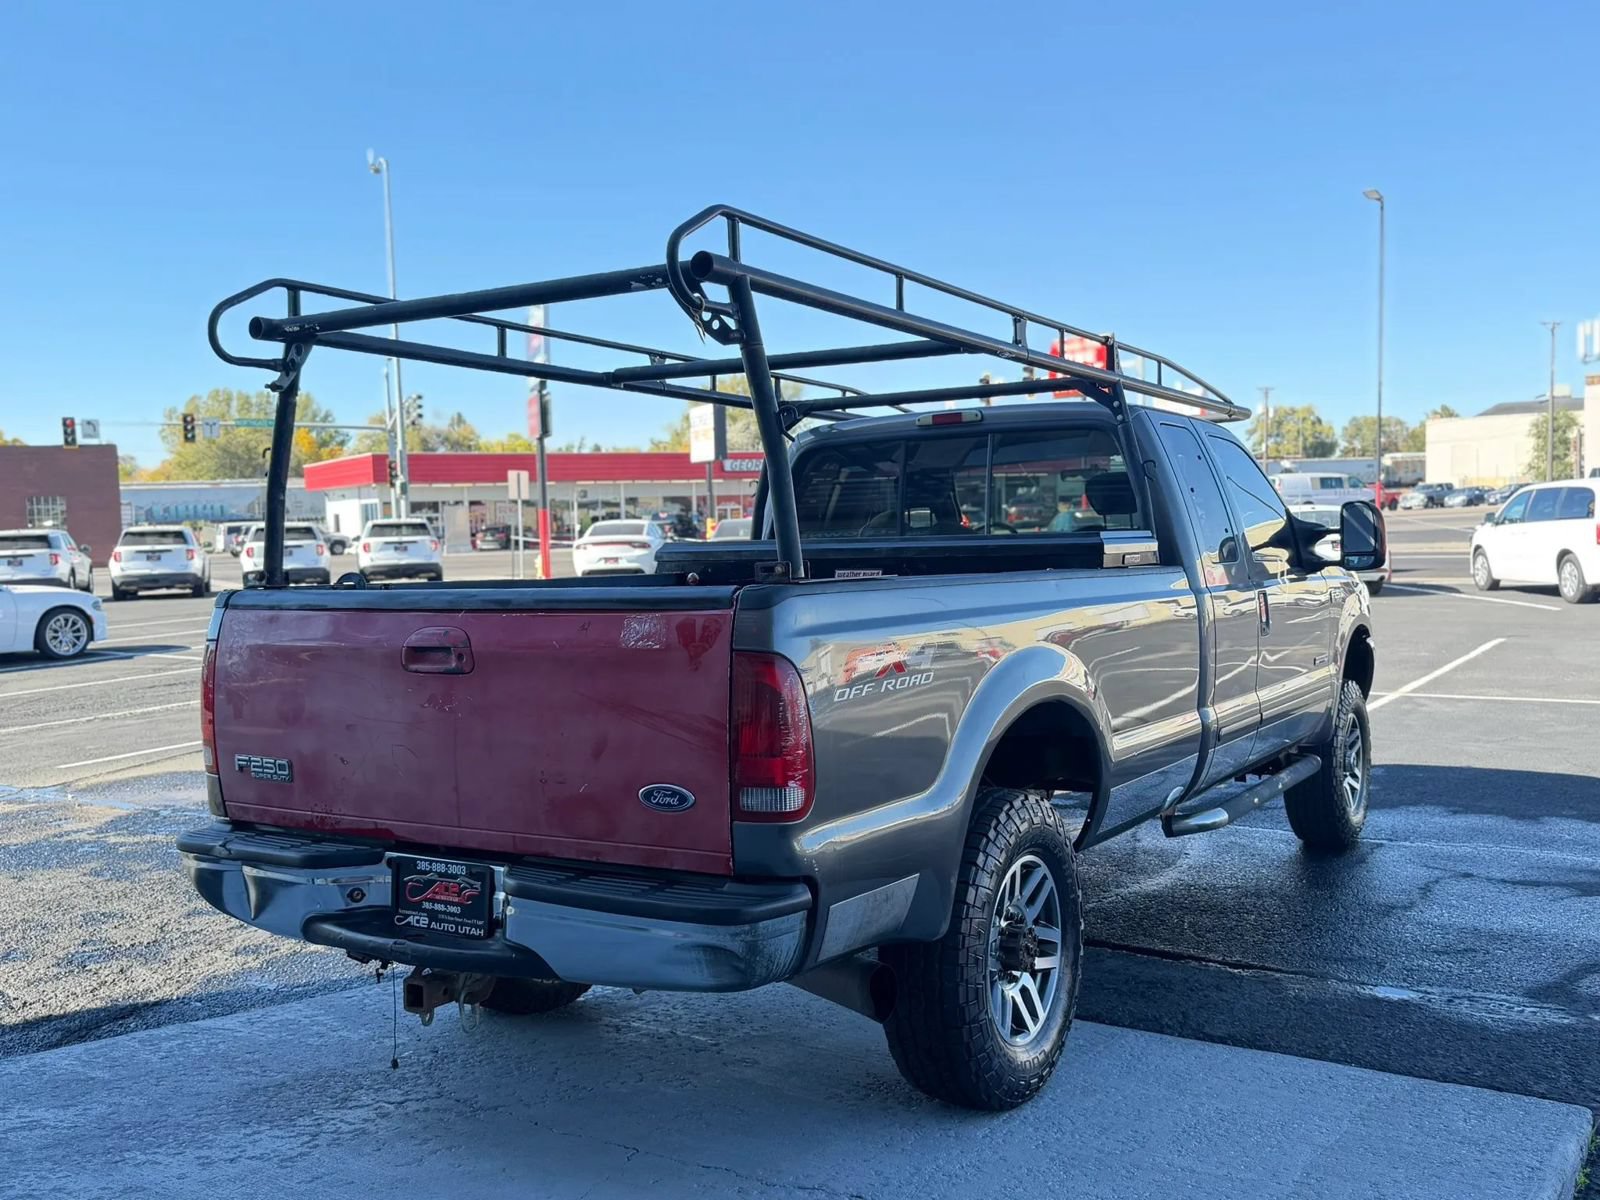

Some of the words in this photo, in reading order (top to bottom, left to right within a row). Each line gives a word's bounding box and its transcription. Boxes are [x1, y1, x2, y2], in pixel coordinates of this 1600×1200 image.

[834, 682, 875, 702] OFF
[881, 672, 934, 693] ROAD
[651, 790, 679, 805] Ford
[416, 860, 466, 875] 385-888-3003
[430, 921, 456, 932] AUTO
[458, 925, 484, 936] UTAH
